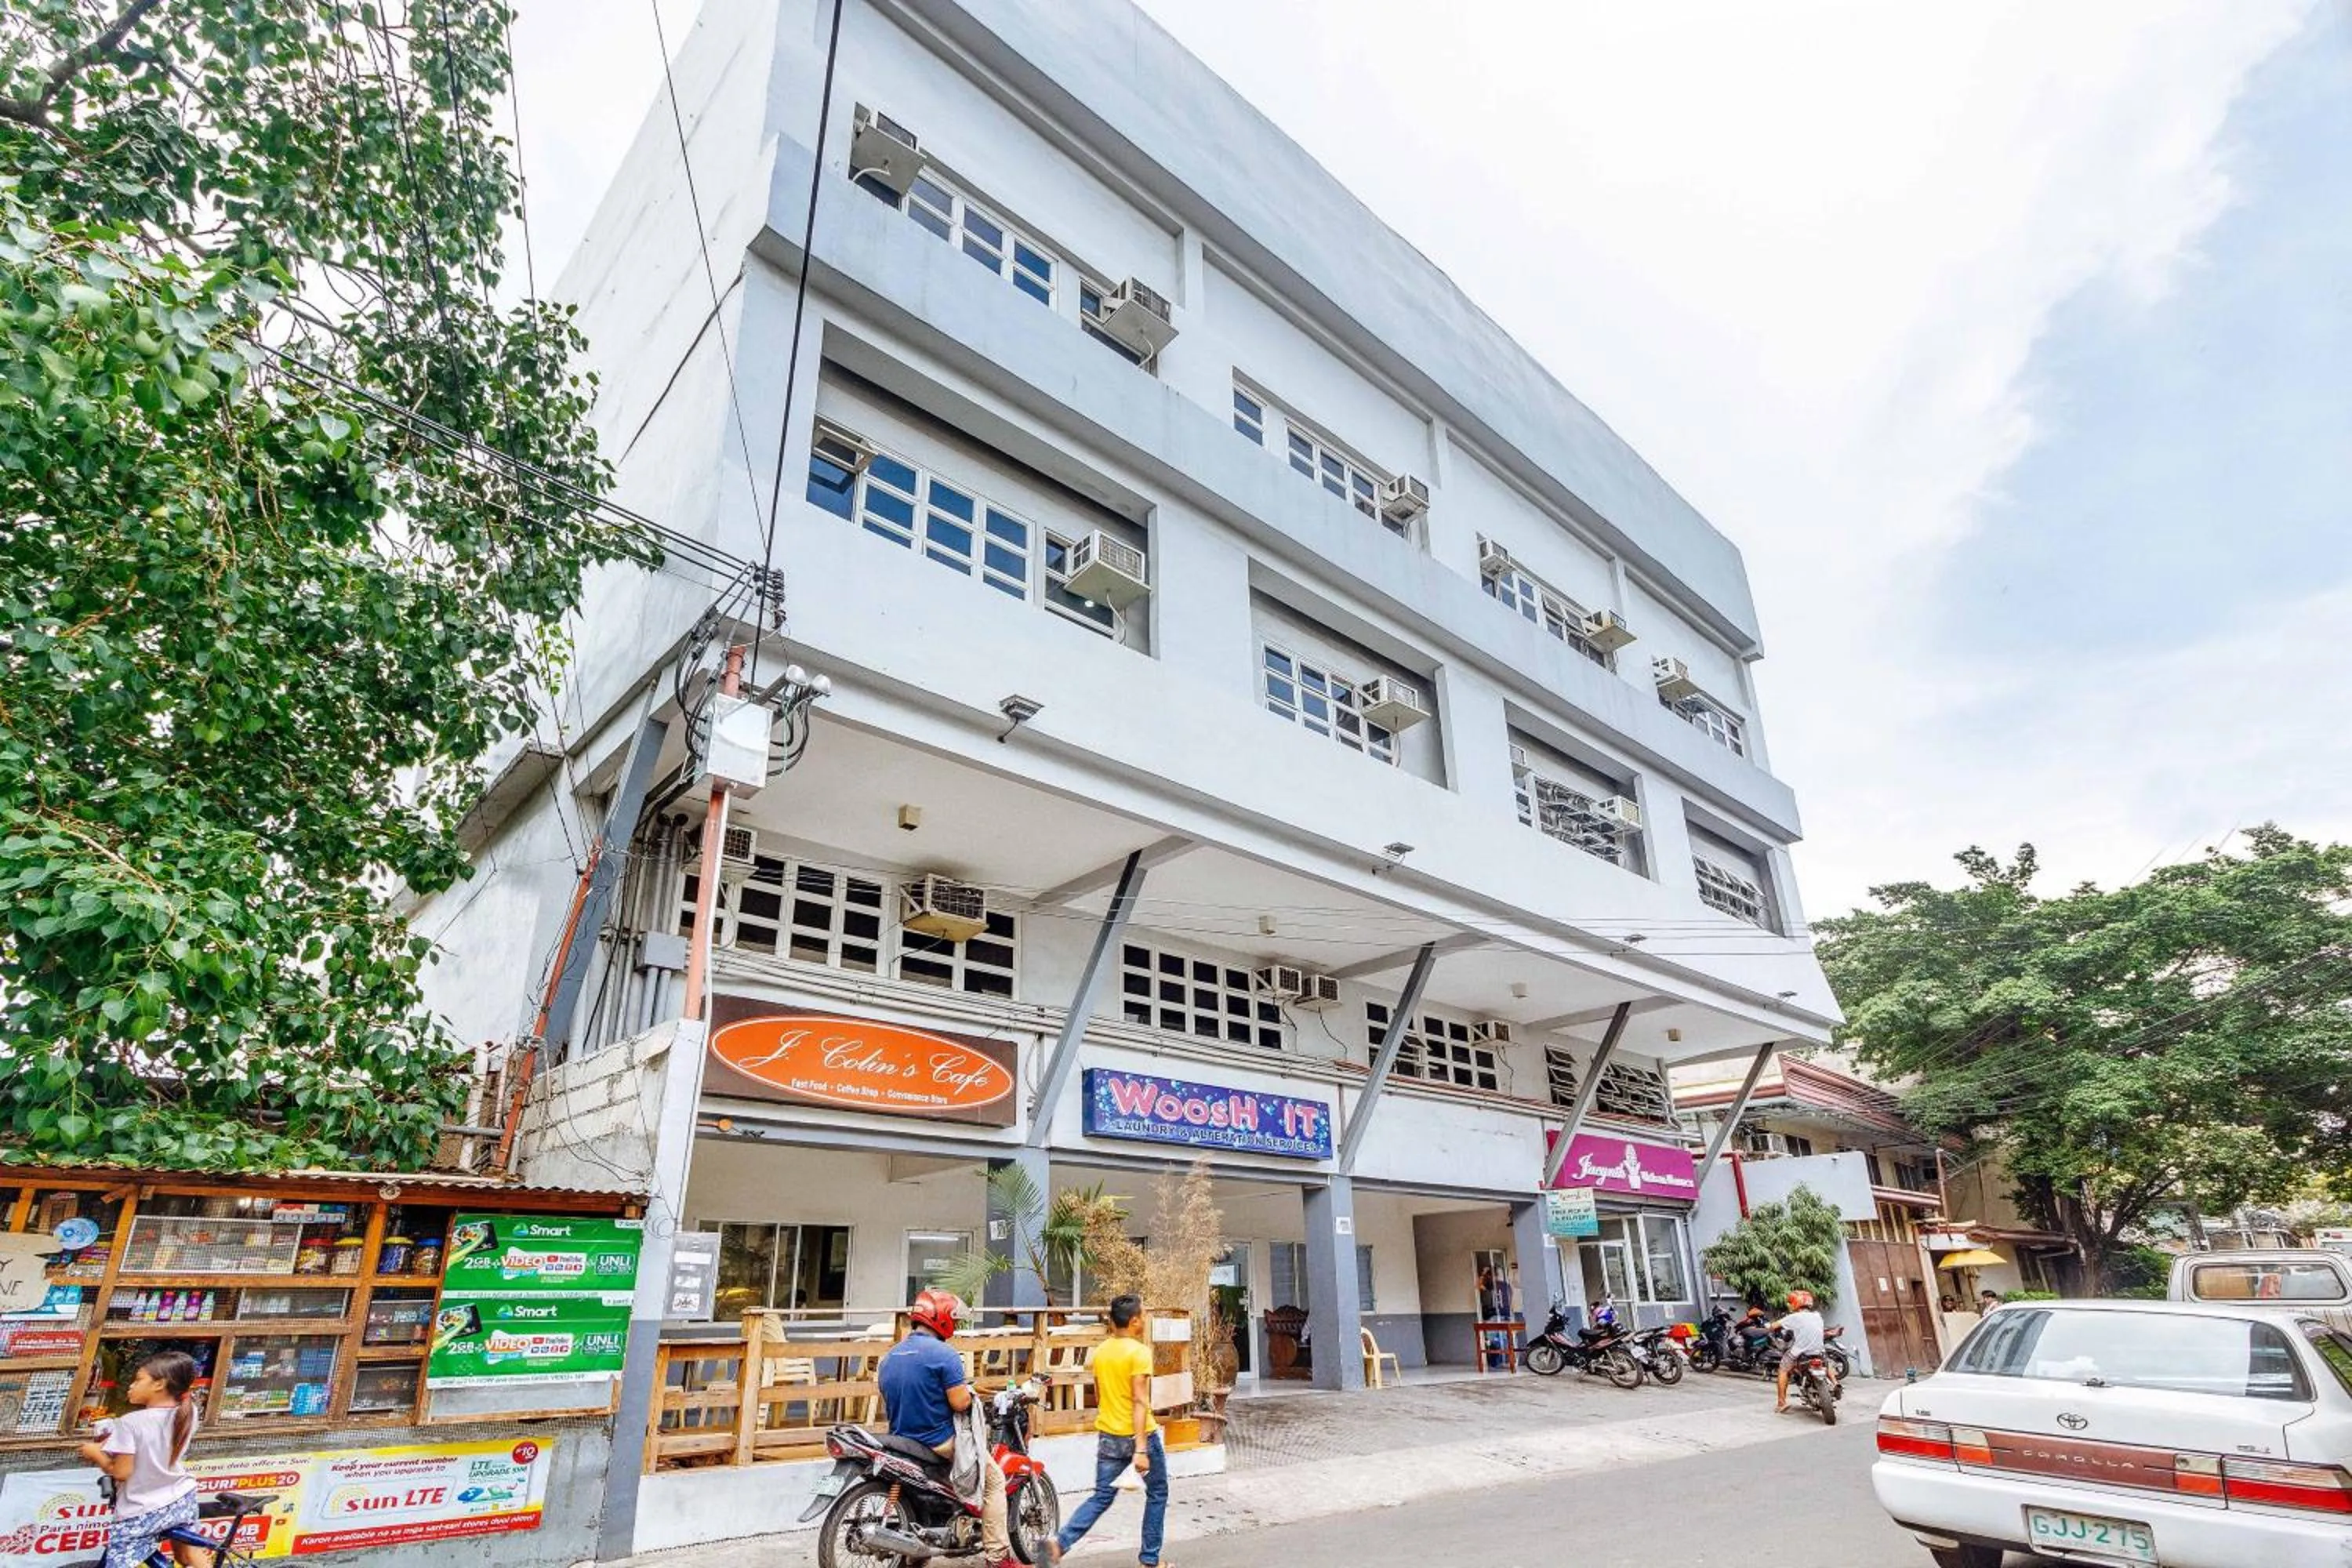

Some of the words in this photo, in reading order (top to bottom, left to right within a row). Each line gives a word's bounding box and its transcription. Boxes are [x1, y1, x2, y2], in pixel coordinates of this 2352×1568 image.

[821, 1037, 919, 1078] Colin's
[791, 1078, 809, 1089] Fast
[810, 1080, 828, 1091] Food
[837, 1083, 859, 1094] Coffee
[862, 1086, 878, 1097] Shop
[1283, 1103, 1318, 1138] IT
[1116, 1122, 1174, 1135] LAUNDRY
[1192, 1129, 1264, 1145] ALTERATION
[529, 1225, 572, 1236] Smart
[600, 1255, 630, 1265] UNLI
[514, 1305, 557, 1317] Smart
[485, 1338, 530, 1351] VIDEO
[587, 1334, 619, 1346] UNLI
[331, 1463, 357, 1472] Keep
[358, 1461, 383, 1471] your
[384, 1459, 419, 1468] current
[422, 1457, 458, 1465] number
[471, 1460, 492, 1470] LTE
[2023, 1450, 2135, 1468] COROLLA
[373, 1470, 393, 1479] you
[394, 1467, 434, 1476] upgrade
[405, 1487, 448, 1506] LTE
[40, 1523, 71, 1534] Para
[301, 1536, 331, 1545] Karon
[332, 1531, 376, 1543] available
[403, 1526, 424, 1535] mga
[463, 1519, 488, 1529] stores
